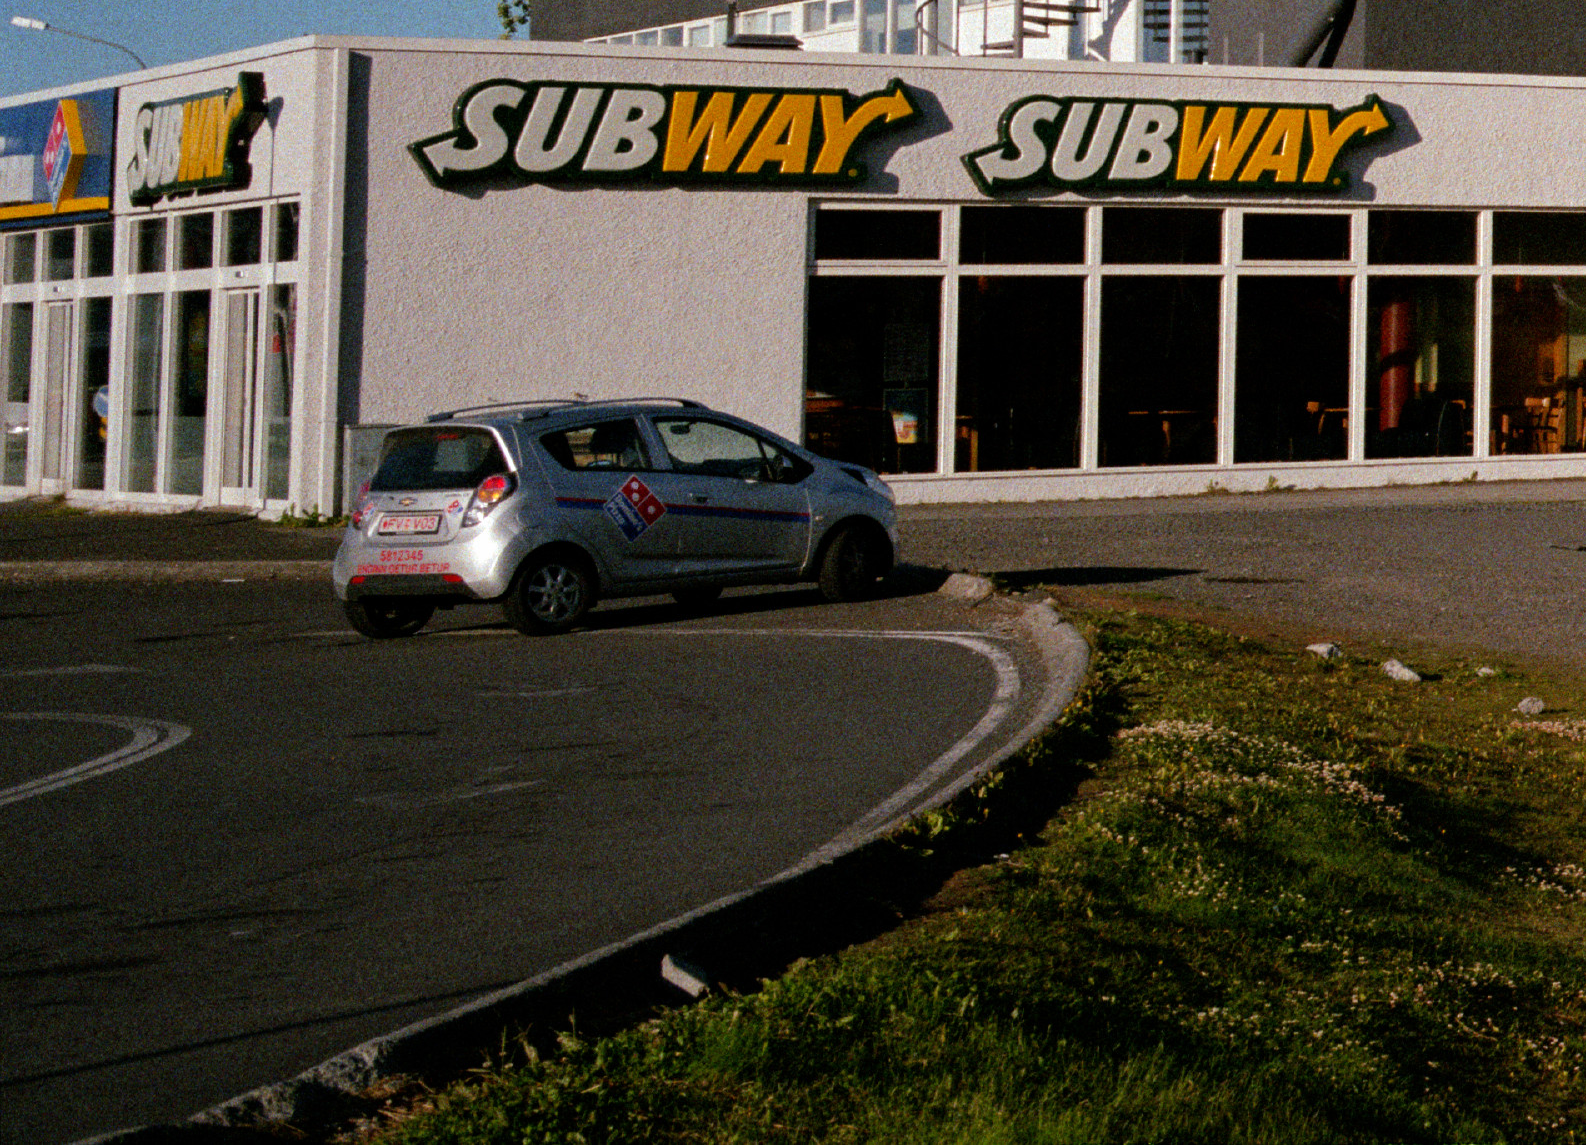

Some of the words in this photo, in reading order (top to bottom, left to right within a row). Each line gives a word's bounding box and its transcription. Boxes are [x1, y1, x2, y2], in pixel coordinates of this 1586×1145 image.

[127, 83, 243, 194] SUBWAY
[422, 84, 914, 177] SUBWAY
[975, 99, 1389, 187] SUBWAY
